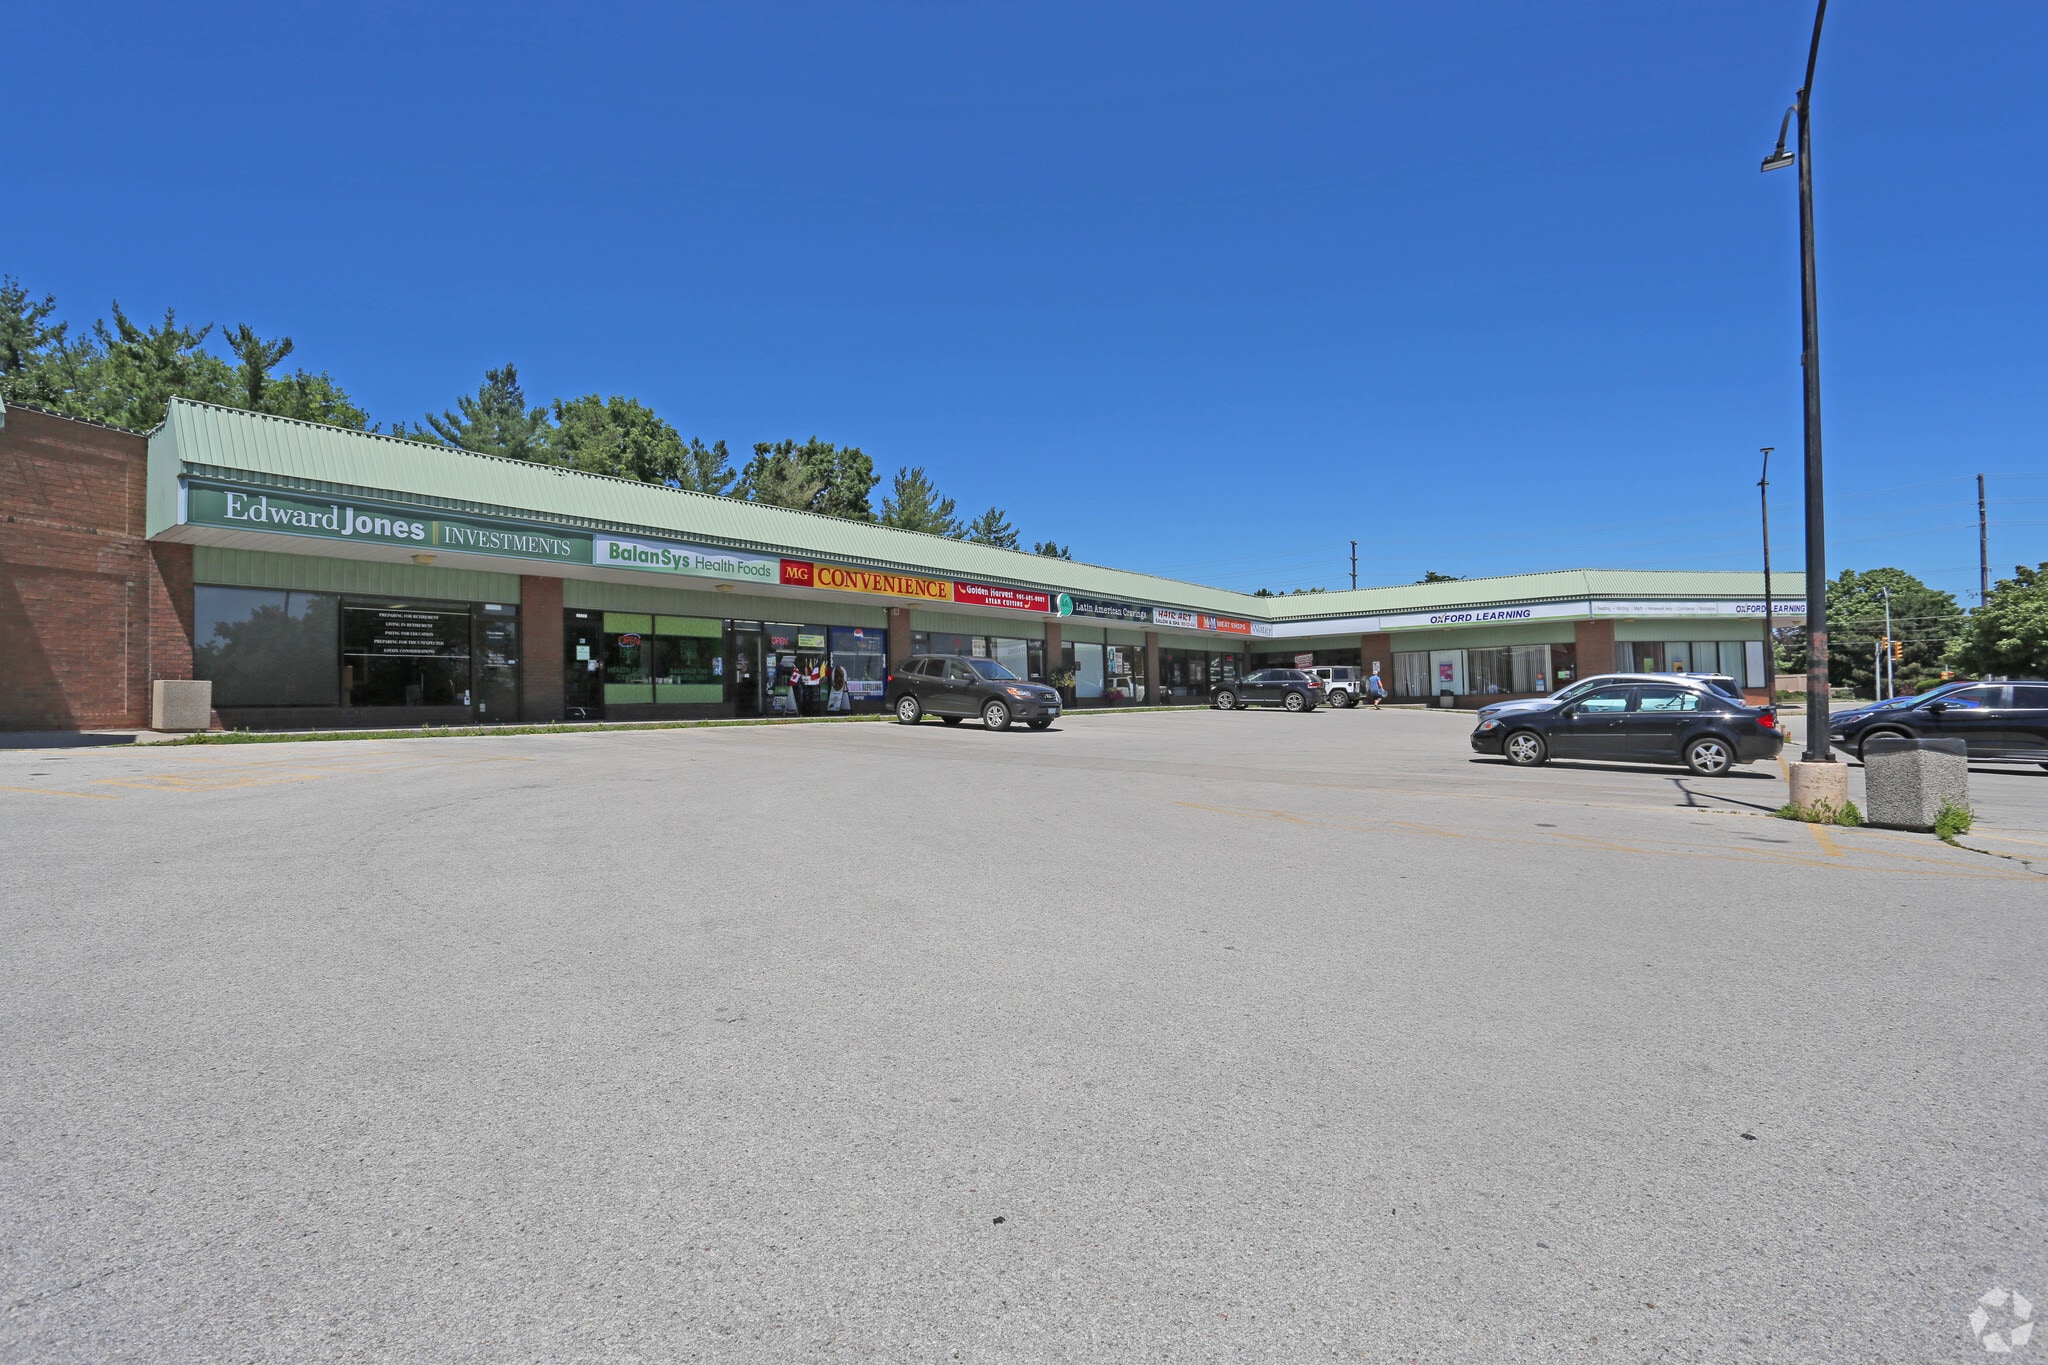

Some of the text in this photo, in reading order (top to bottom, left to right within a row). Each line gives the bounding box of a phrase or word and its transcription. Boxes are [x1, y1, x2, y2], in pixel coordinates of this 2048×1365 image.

[444, 526, 571, 556] INVESTMENTS
[609, 542, 771, 577] BalanSys Health Foods
[785, 566, 947, 598] MG CONVENIENCE
[966, 585, 989, 596] Golden
[990, 587, 1014, 599] Harvest
[985, 597, 1024, 608] ASIAN CUISINE
[1735, 603, 1806, 613] OXFORD EARNING
[1076, 602, 1147, 620] Latin American Cravings
[1158, 609, 1192, 621] HAIR ART
[1430, 613, 1472, 624] OXFORD
[1476, 609, 1531, 621] LEARNING
[1217, 620, 1231, 629] MEAT
[1231, 622, 1246, 631] SHOPS
[1252, 624, 1272, 636] Water
[618, 635, 641, 645] OPEN
[771, 636, 789, 645] OPEN
